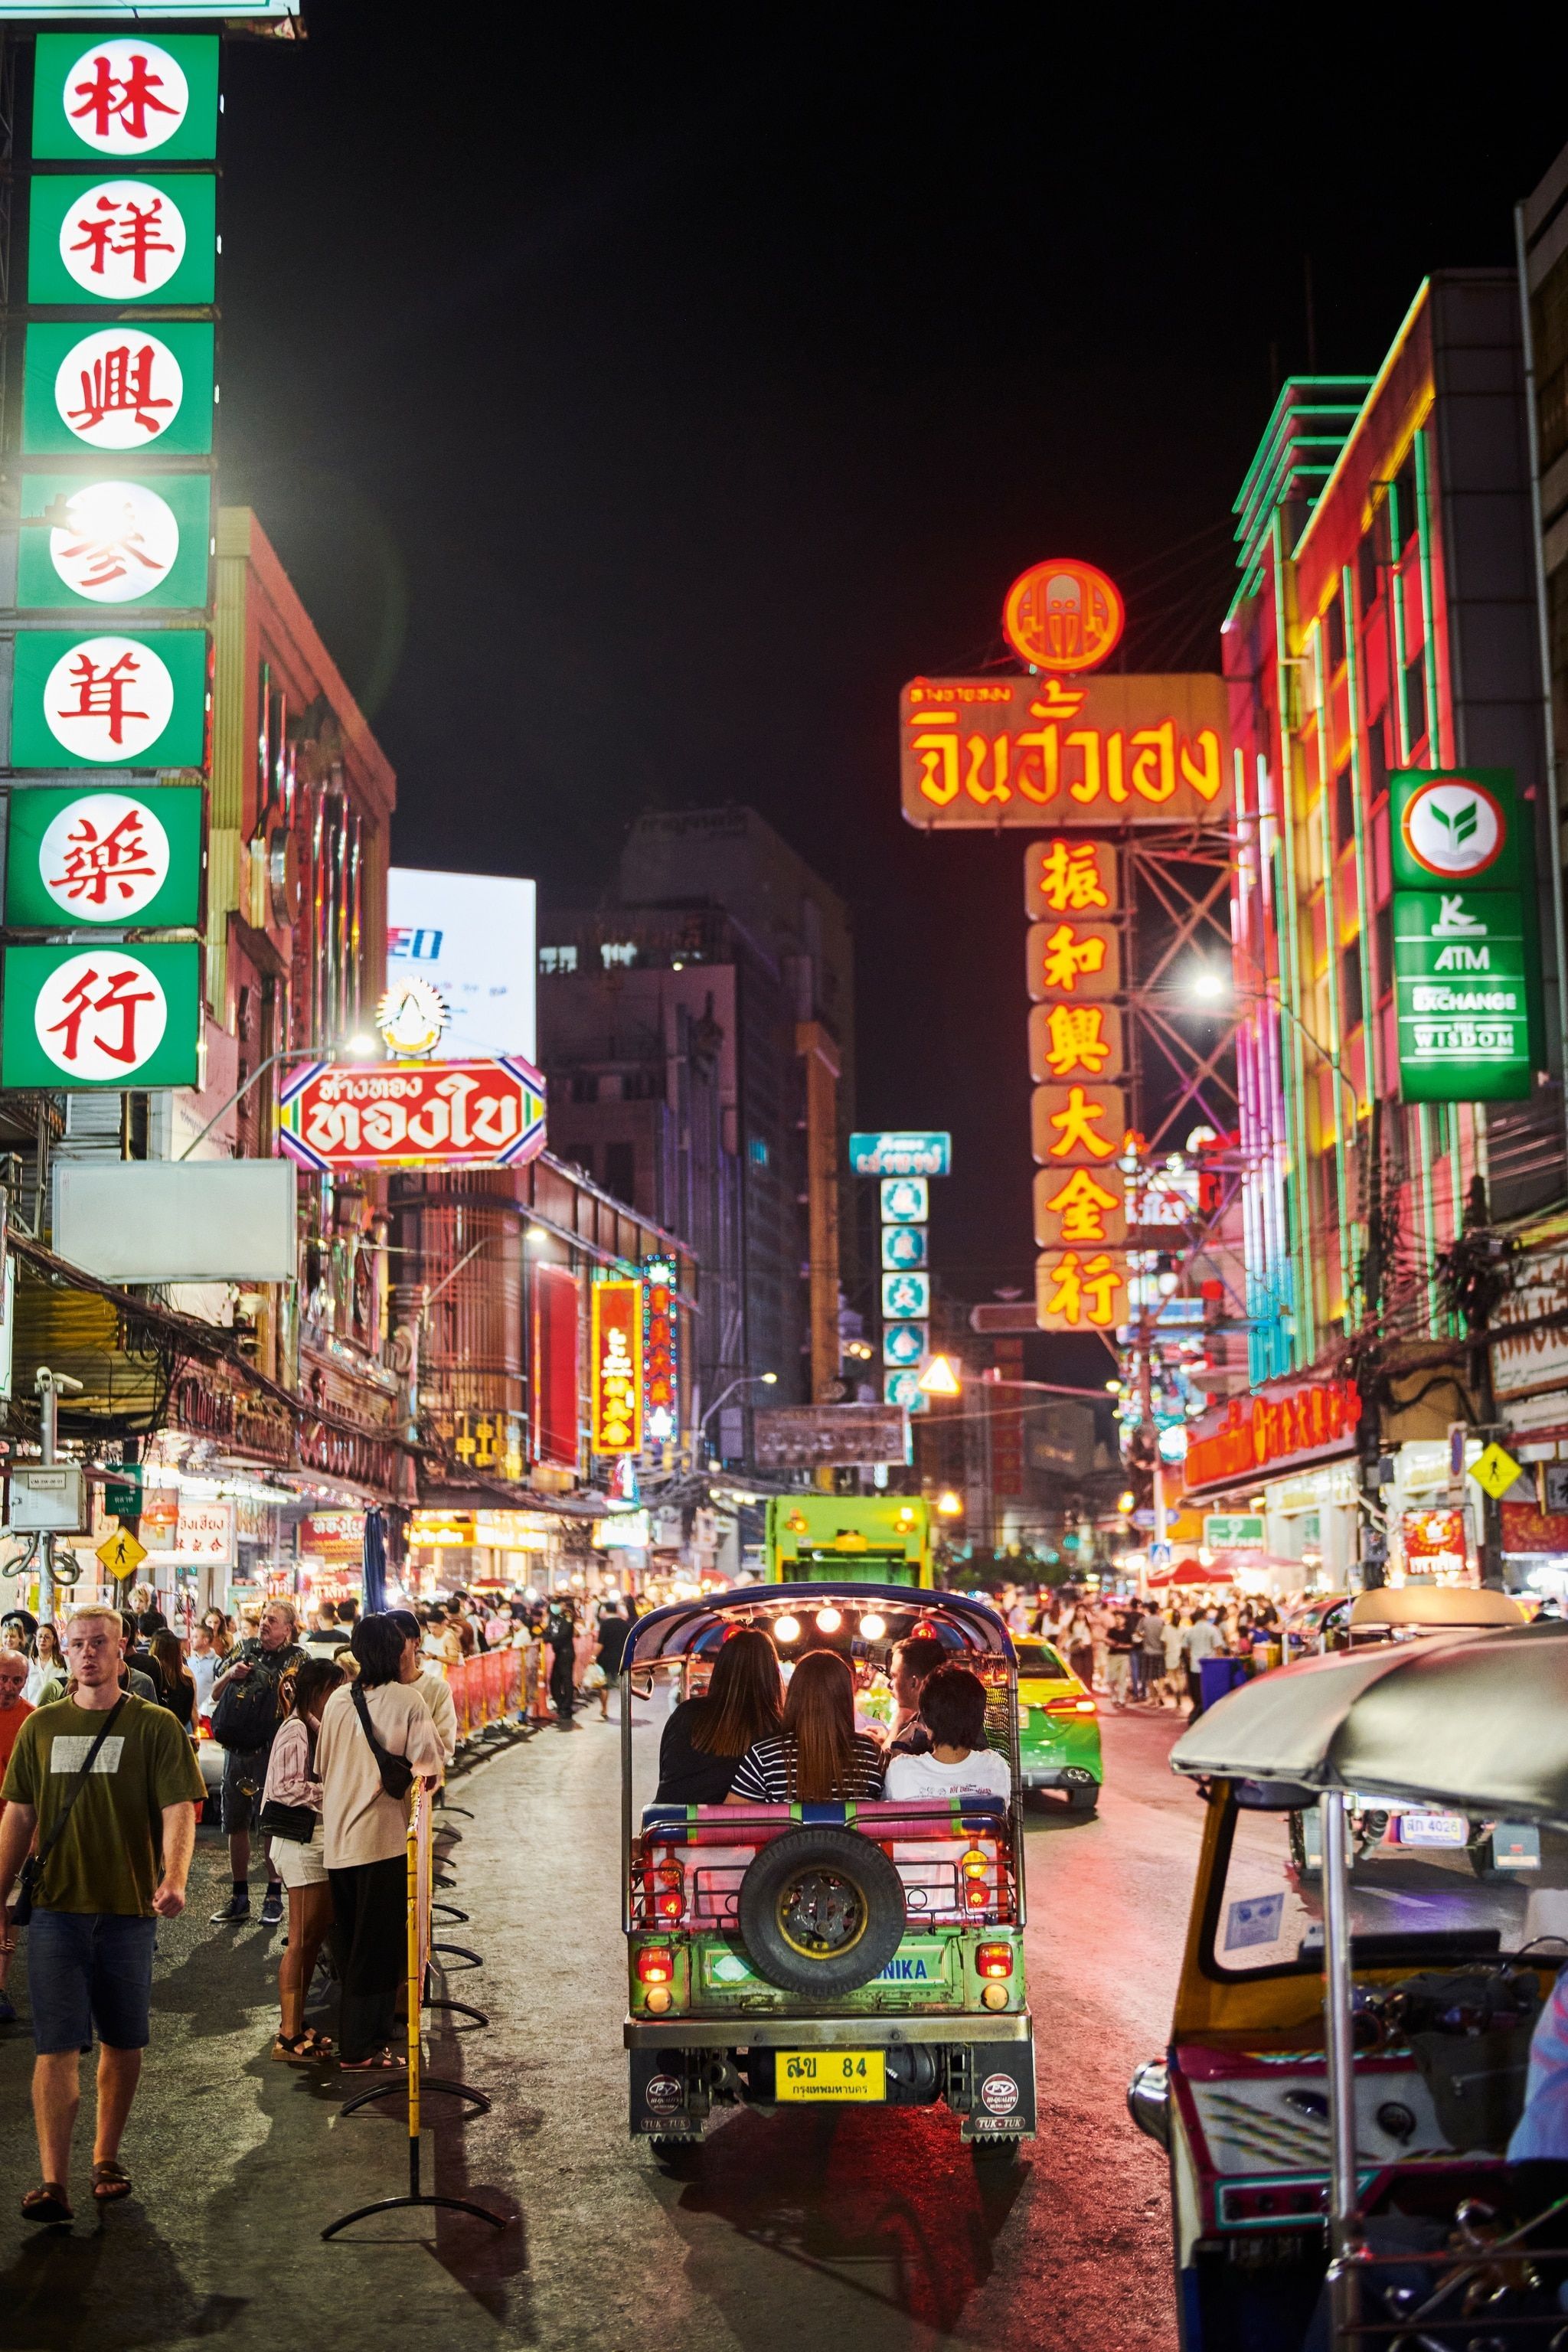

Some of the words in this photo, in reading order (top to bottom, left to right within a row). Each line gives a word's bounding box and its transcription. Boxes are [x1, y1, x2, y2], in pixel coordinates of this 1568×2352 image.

[907, 678, 1222, 807] จินฮั้วเฮง
[1434, 946, 1490, 971] ATM
[1413, 991, 1517, 1011] EXCHANGE
[1414, 1031, 1514, 1047] WISDOM
[318, 1073, 423, 1101] ห้างทอง
[1039, 839, 1124, 1326] 振和興大金行
[305, 1073, 519, 1151] ทองใบ
[842, 2057, 867, 2077] 84
[792, 2085, 867, 2097] กรุงเทพมหานคร
